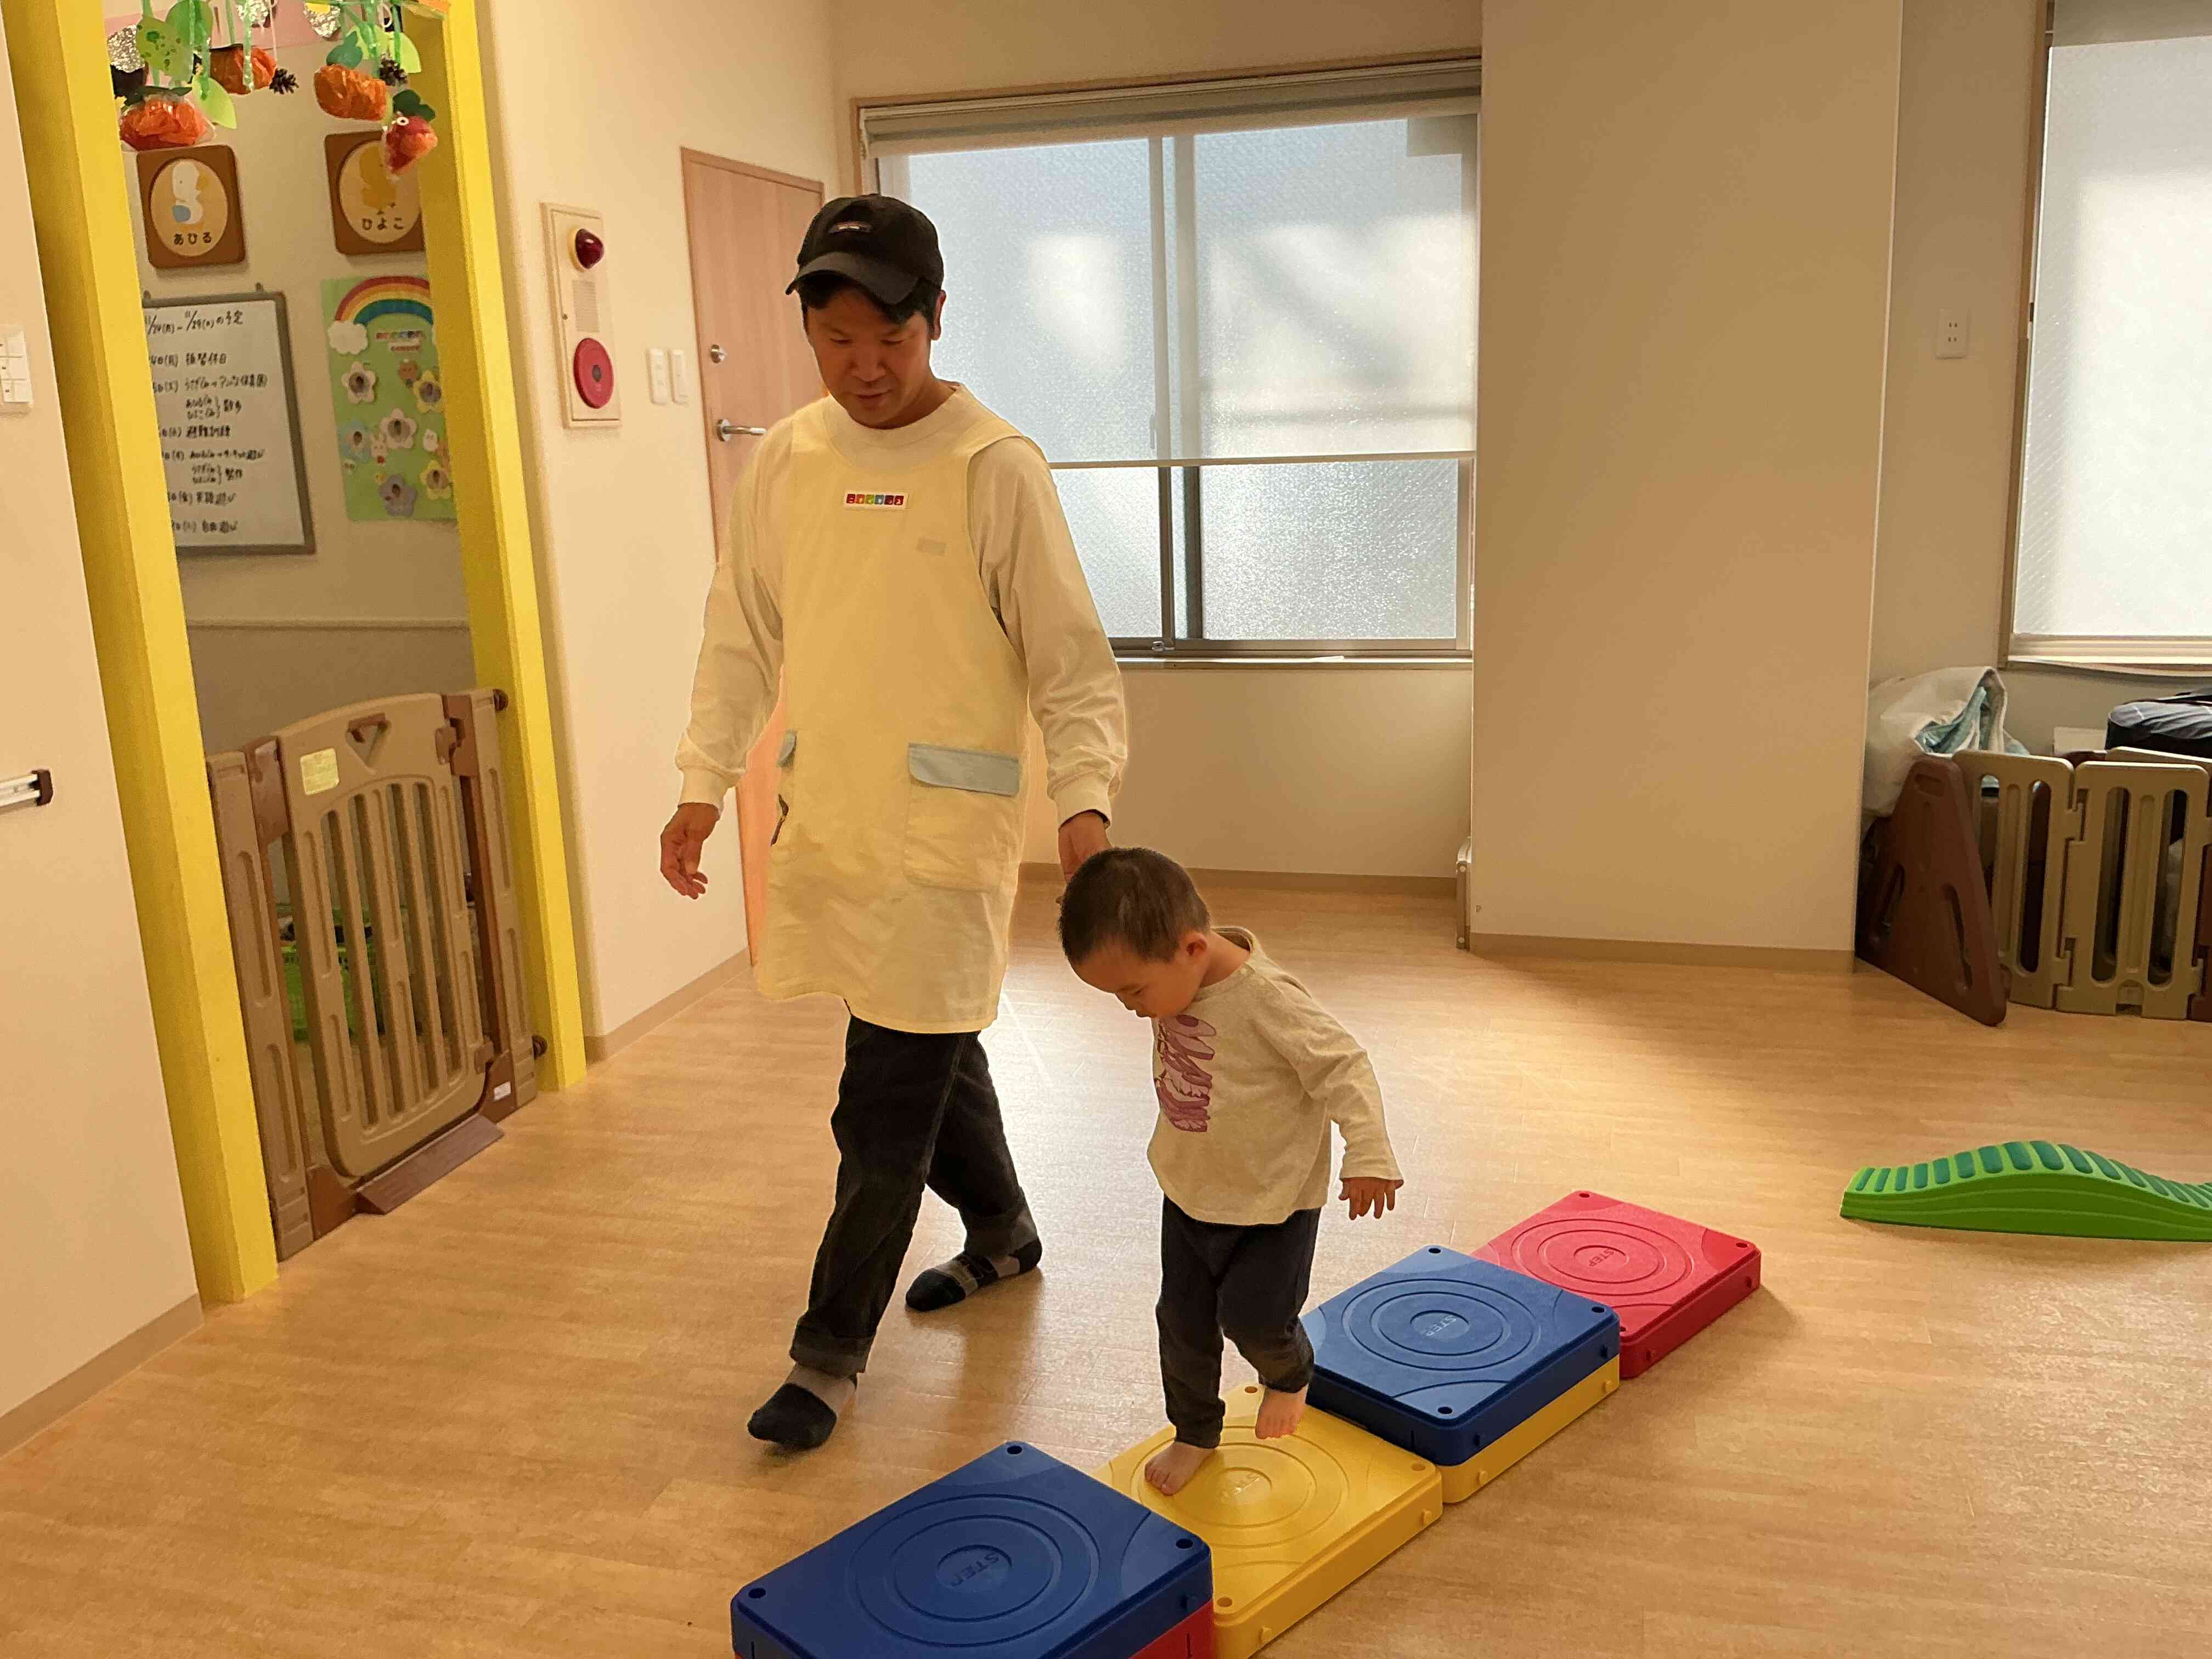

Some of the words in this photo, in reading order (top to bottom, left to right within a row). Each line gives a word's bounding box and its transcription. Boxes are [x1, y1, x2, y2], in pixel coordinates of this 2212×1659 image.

[362, 217, 404, 230] ひよこ
[173, 232, 212, 245] あひる
[1588, 1249, 1614, 1267] STEP
[1423, 1314, 1457, 1337] STEP
[951, 1553, 999, 1587] STEP
